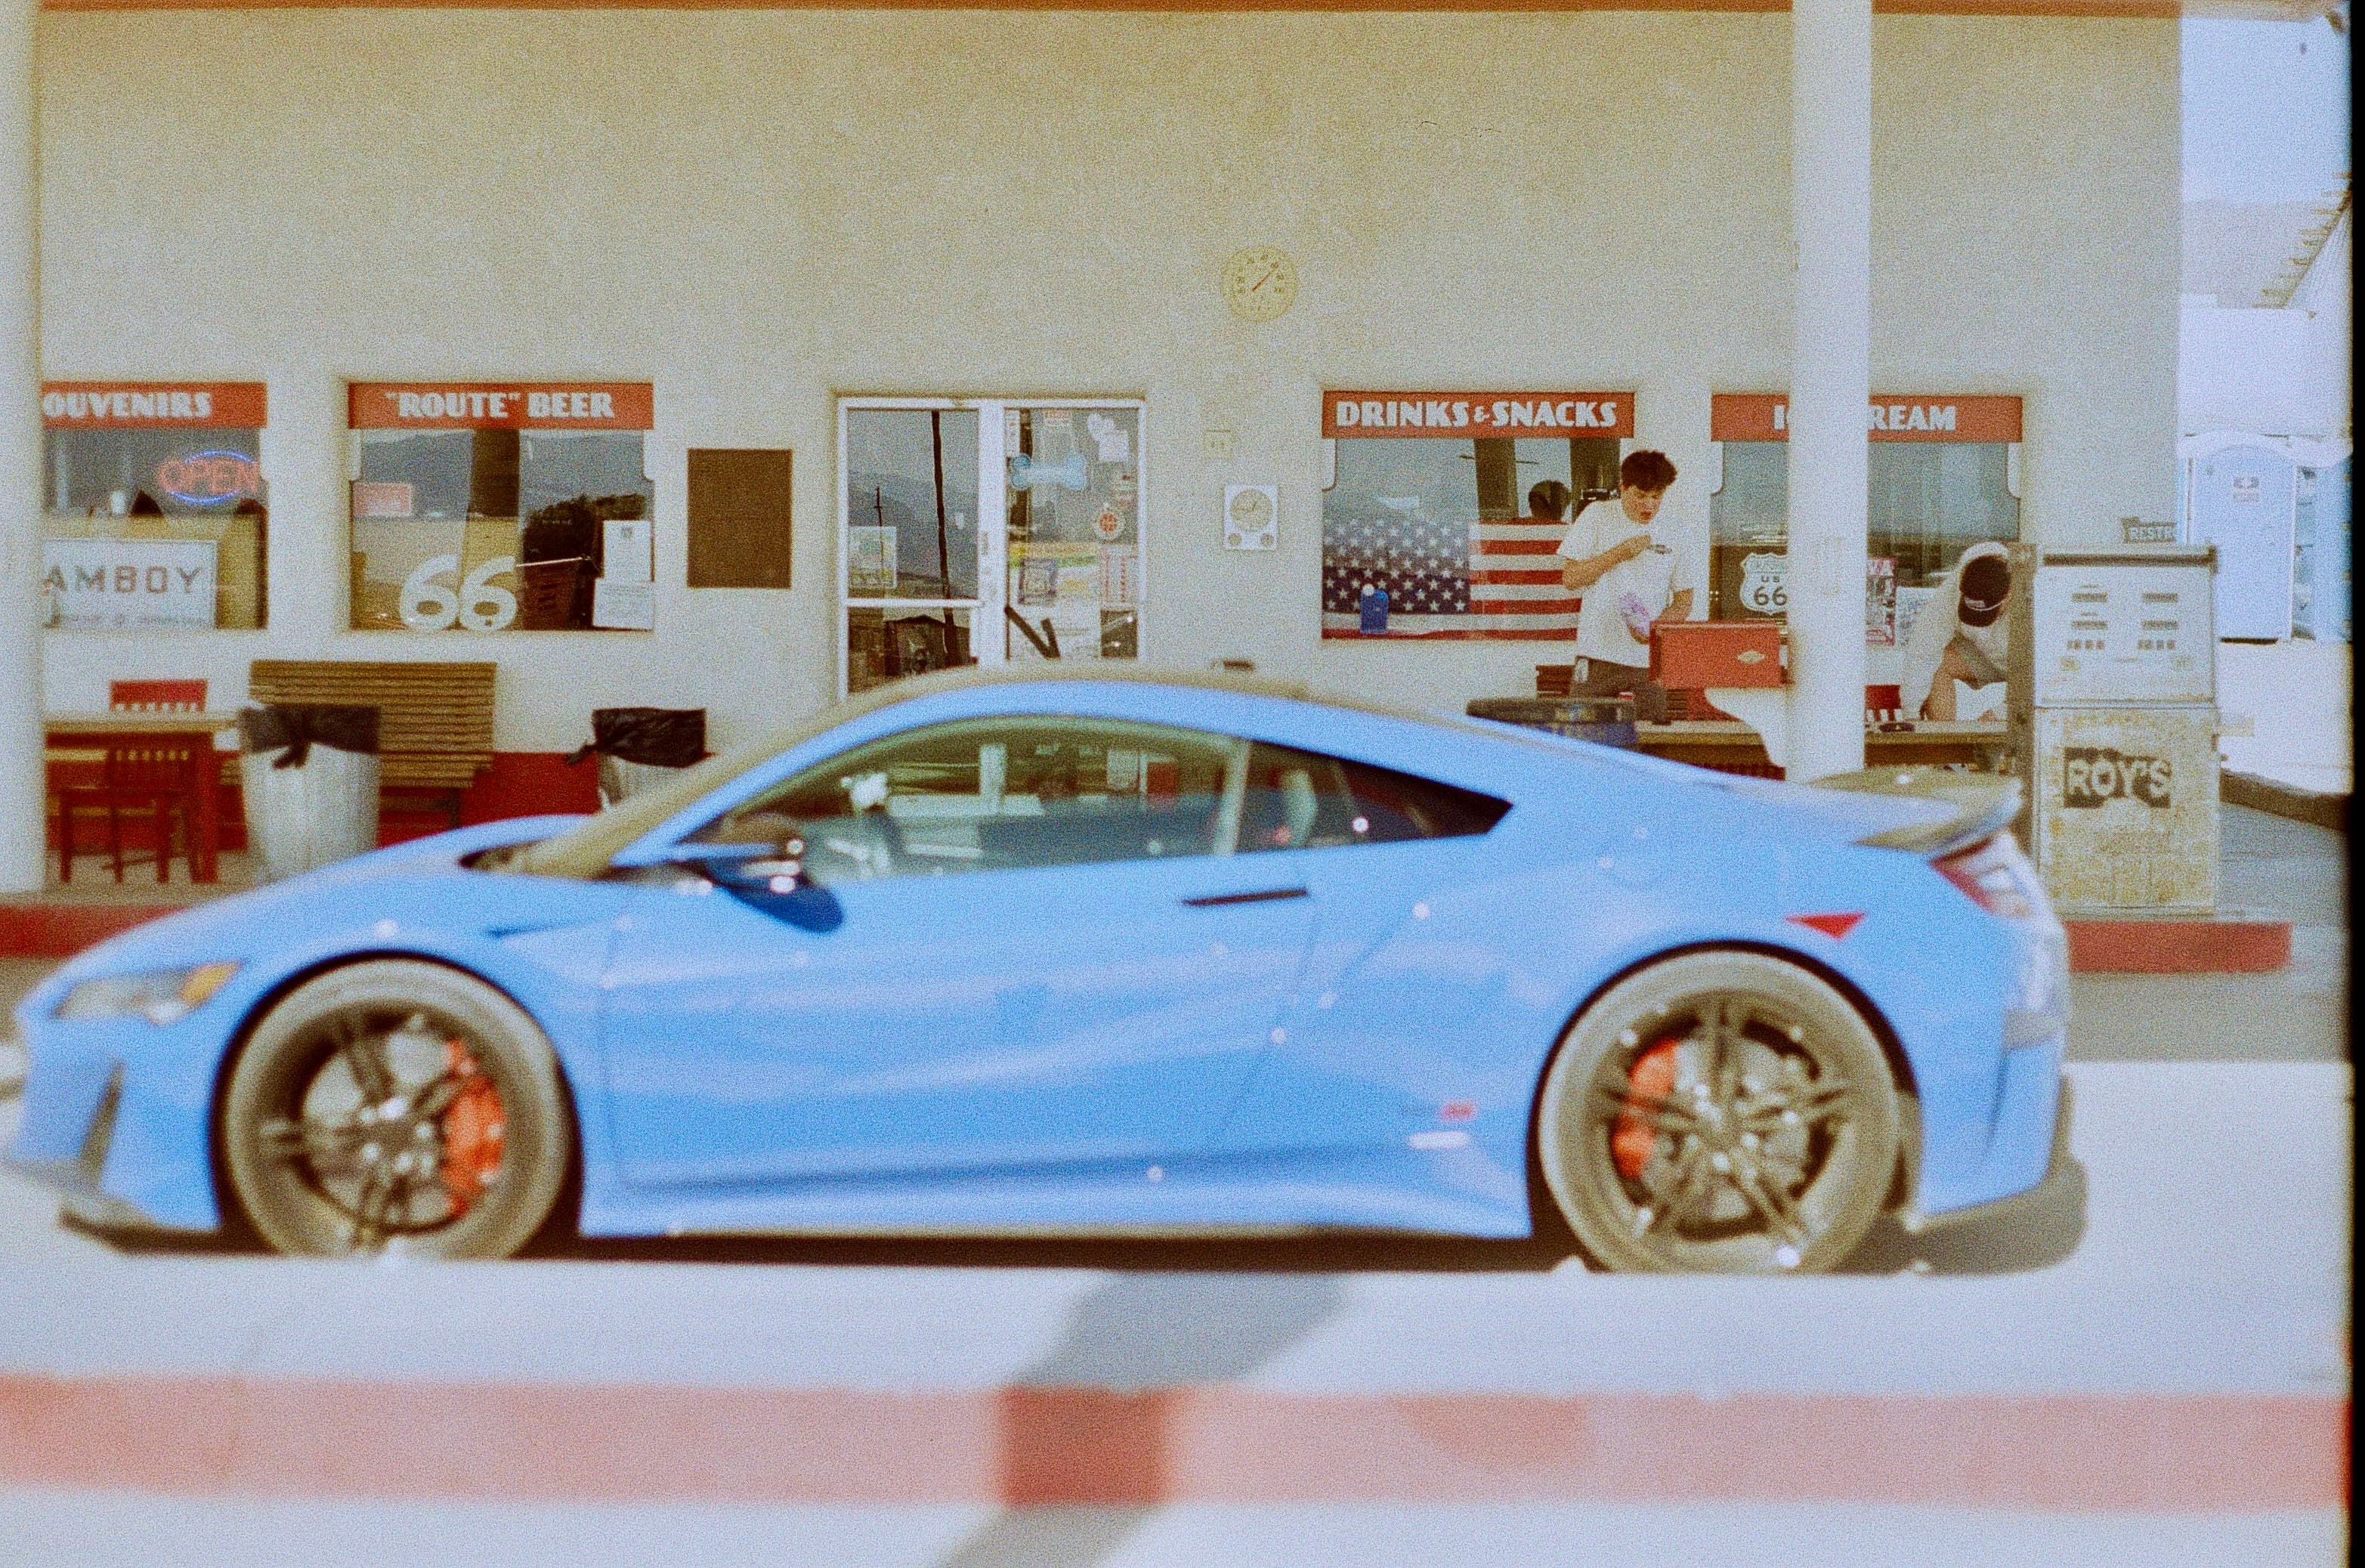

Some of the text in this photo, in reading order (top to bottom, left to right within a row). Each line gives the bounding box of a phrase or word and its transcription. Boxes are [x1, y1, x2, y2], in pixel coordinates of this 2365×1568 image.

[385, 391, 615, 418] "ROUTE" BEER
[1335, 400, 1618, 428] DRINKS & SNACKS
[1773, 404, 1789, 430] I
[42, 565, 200, 595] AMBOY
[400, 553, 518, 632] 66
[1753, 586, 1788, 607] 66
[2068, 757, 2172, 799] ROY'S
